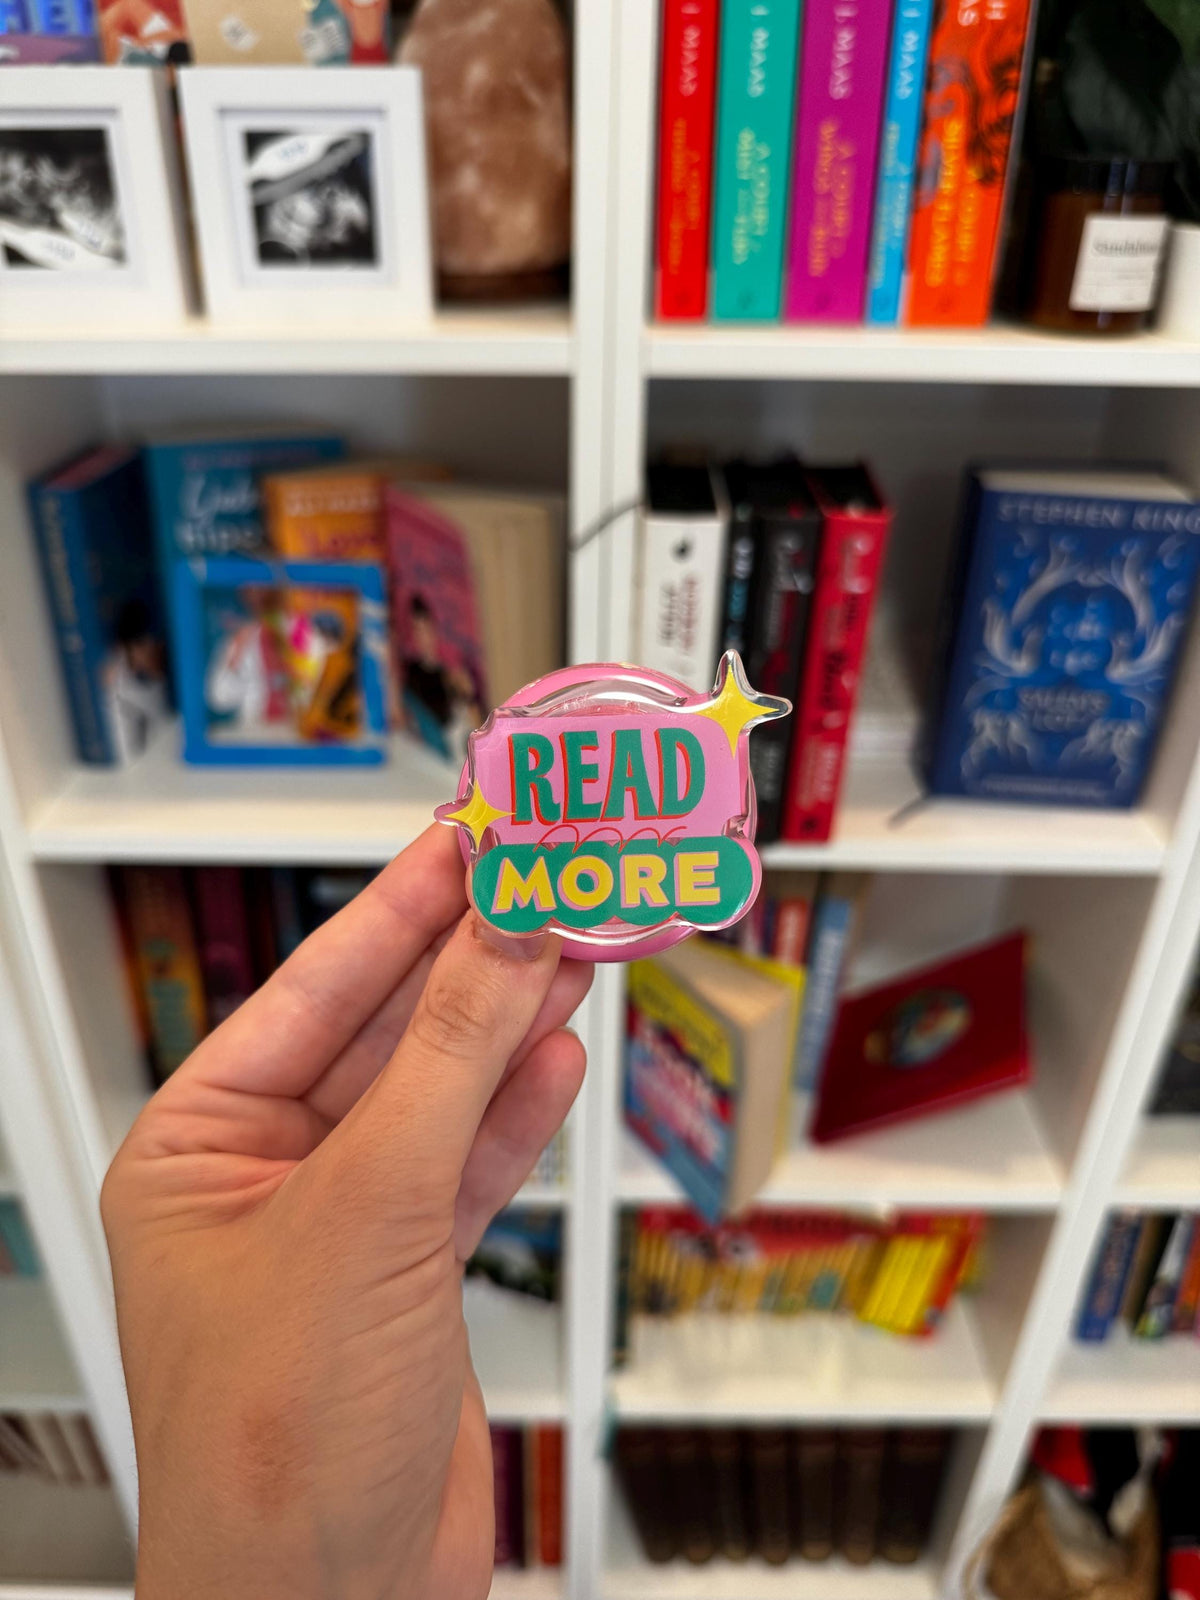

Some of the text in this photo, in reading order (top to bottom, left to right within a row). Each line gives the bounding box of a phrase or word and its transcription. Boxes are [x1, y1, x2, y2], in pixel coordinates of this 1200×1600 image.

[999, 498, 1123, 529] STEPHEN
[507, 727, 706, 826] READ
[490, 850, 721, 915] MORE
